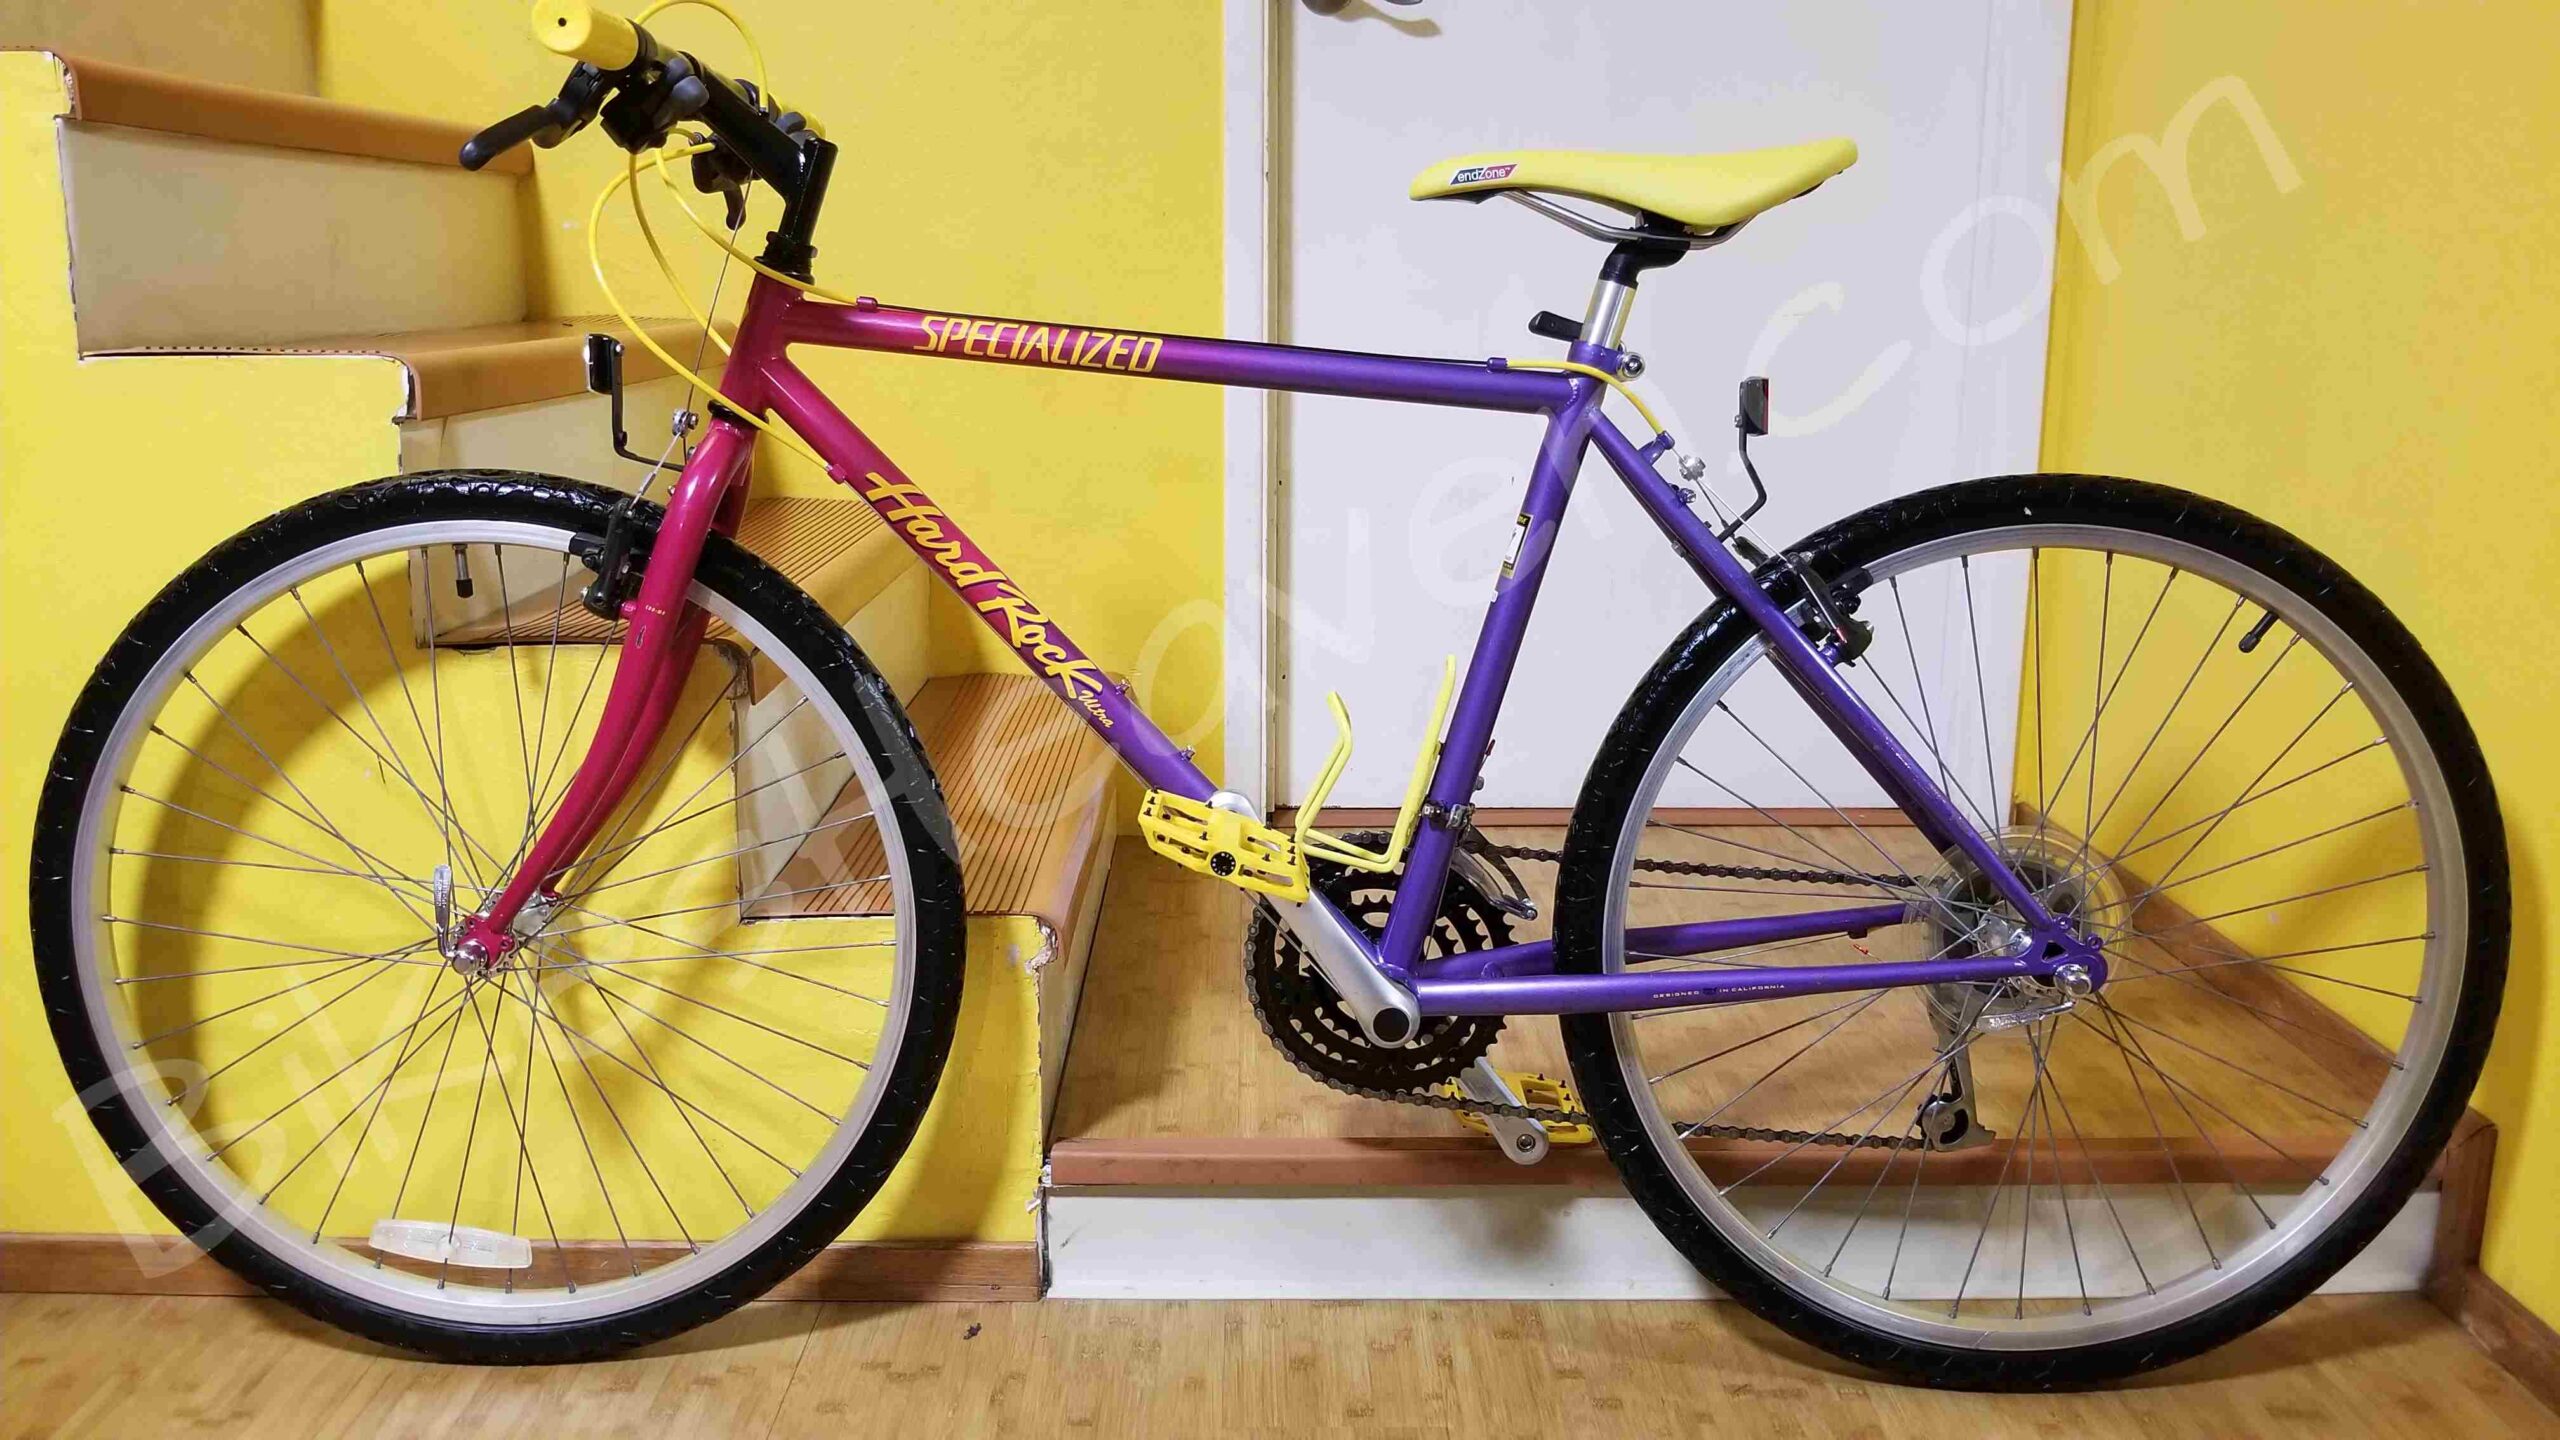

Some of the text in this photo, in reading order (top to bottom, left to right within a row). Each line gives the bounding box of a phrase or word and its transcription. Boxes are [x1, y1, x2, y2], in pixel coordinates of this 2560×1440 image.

[913, 315, 1164, 373] SPECIALIZED
[865, 472, 1114, 728] Hard Rock Ultra
[1653, 990, 1700, 999] DESIGNED
[1731, 984, 1785, 993] CALIFORNIA
